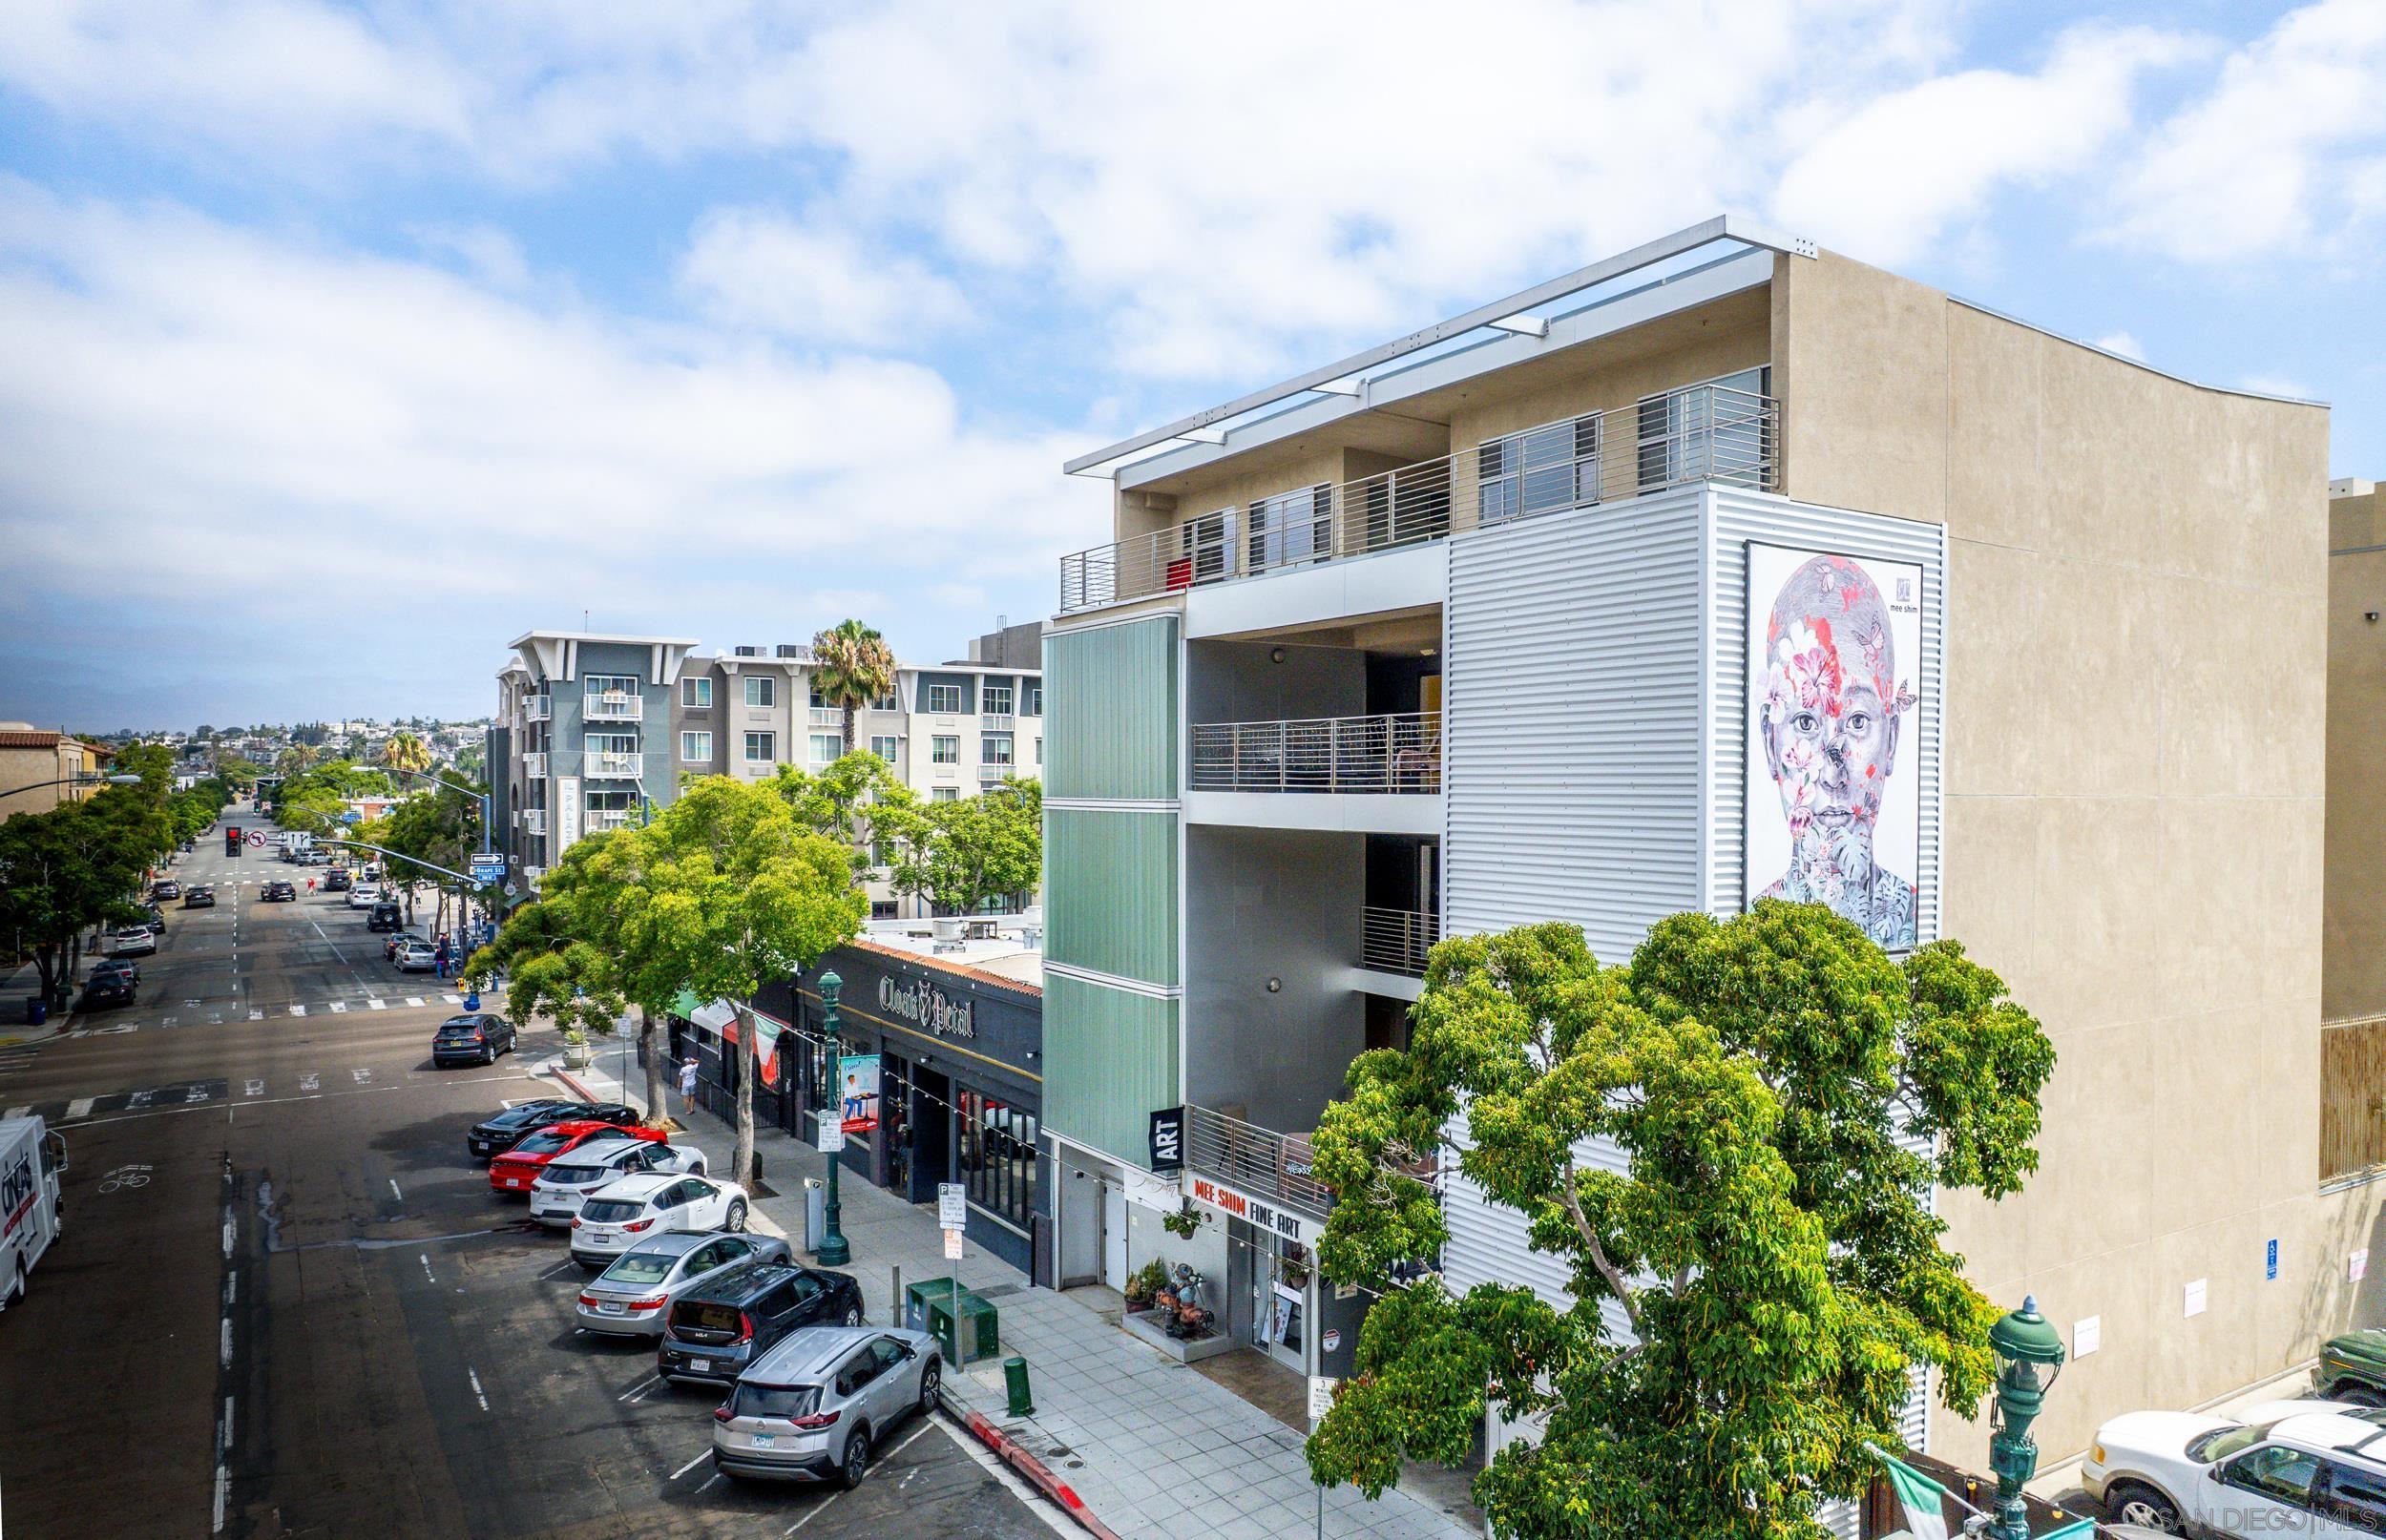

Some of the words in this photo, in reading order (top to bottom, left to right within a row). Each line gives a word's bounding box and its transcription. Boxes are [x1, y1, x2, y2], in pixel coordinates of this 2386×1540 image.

[1890, 604, 1903, 613] mee
[1904, 604, 1918, 614] shim
[878, 975, 918, 1021] Cloak
[931, 989, 973, 1039] Petal
[1155, 1120, 1178, 1160] ART
[1194, 1178, 1215, 1203] MEE
[1218, 1189, 1245, 1217] SHIM
[1249, 1202, 1274, 1228] FINE
[1277, 1213, 1301, 1239] ART
